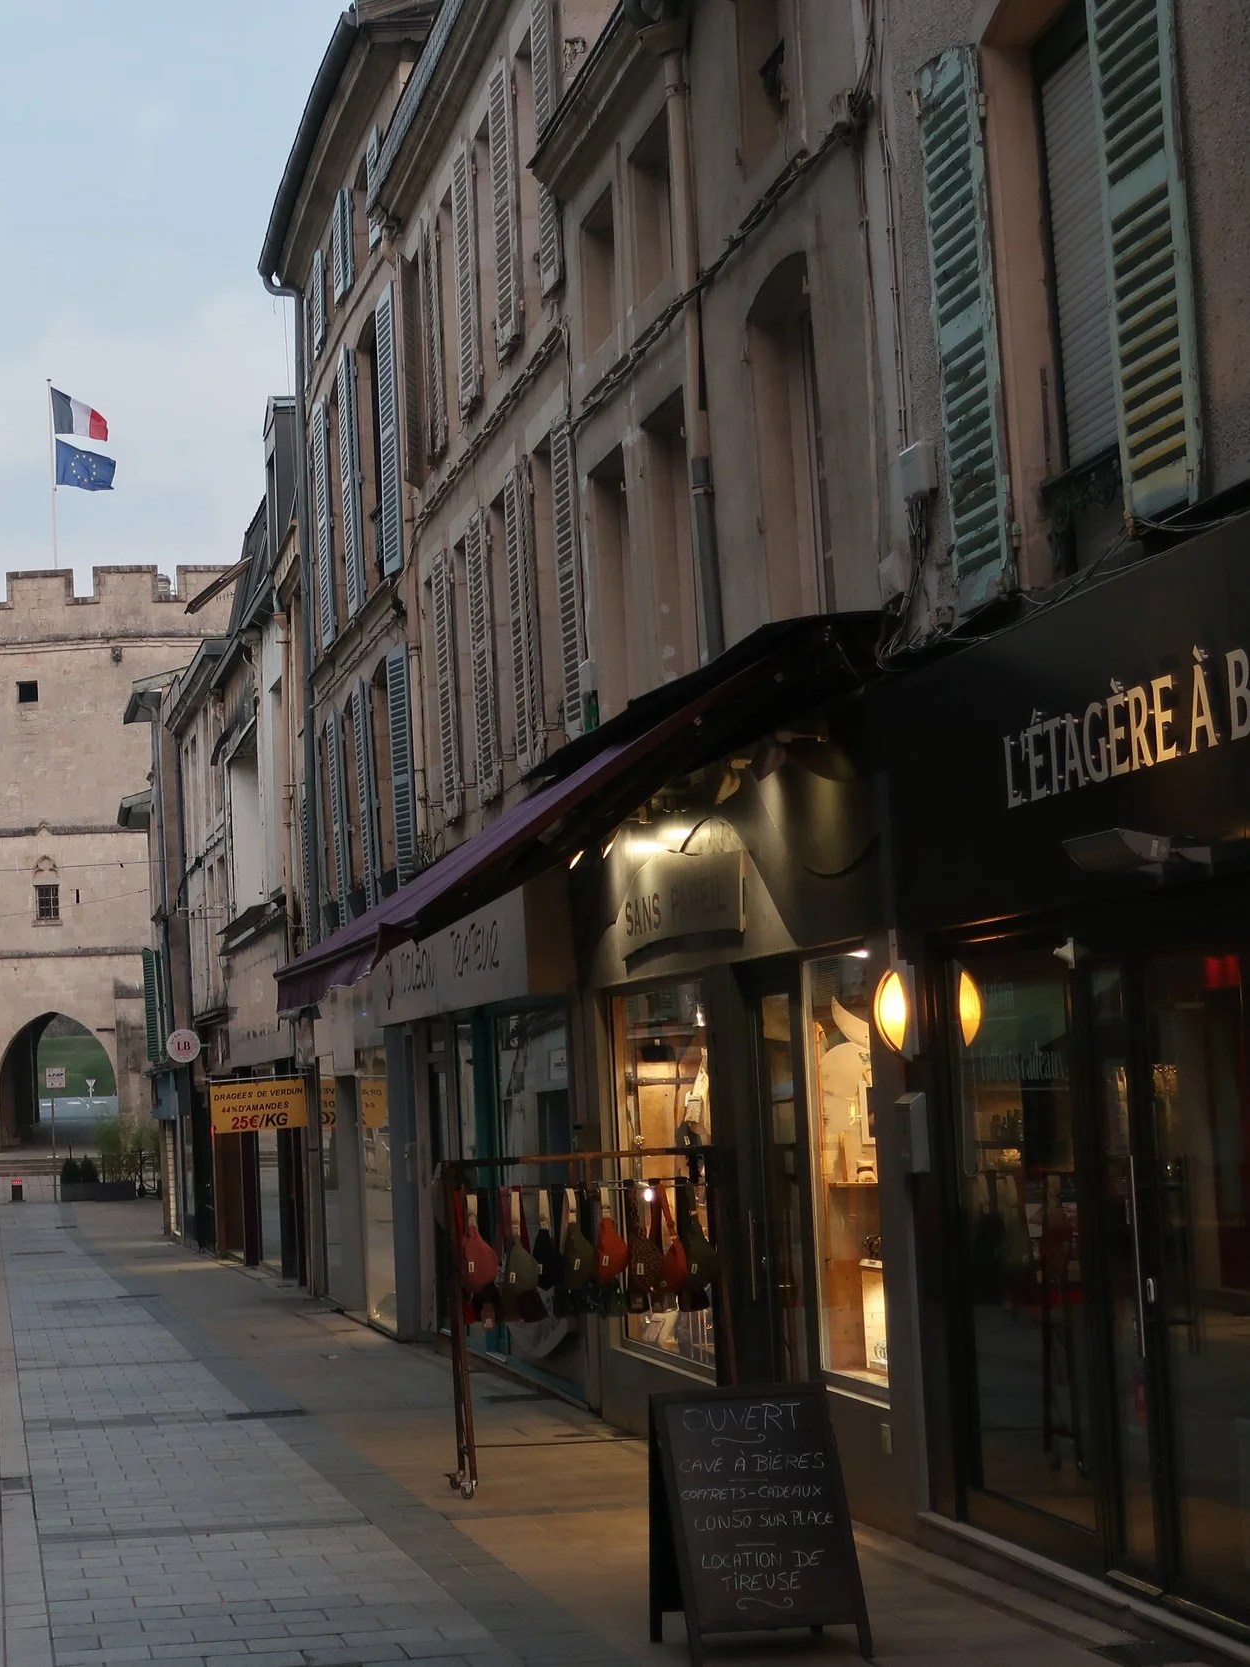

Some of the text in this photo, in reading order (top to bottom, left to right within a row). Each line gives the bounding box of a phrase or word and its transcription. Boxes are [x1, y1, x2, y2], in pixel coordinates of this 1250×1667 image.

[1002, 674, 1180, 810] L'ÉTAGÈRE
[1188, 644, 1221, 755] À
[625, 892, 663, 937] SANS
[213, 1086, 304, 1102] DRAGÉES DE VERDUN
[231, 1111, 289, 1131] 25€/KG
[682, 1402, 801, 1433] OUVERT
[679, 1457, 724, 1474] CAVE
[694, 1509, 835, 1532] CONSO SUR PLACE
[701, 1548, 827, 1570] LOCATION DE
